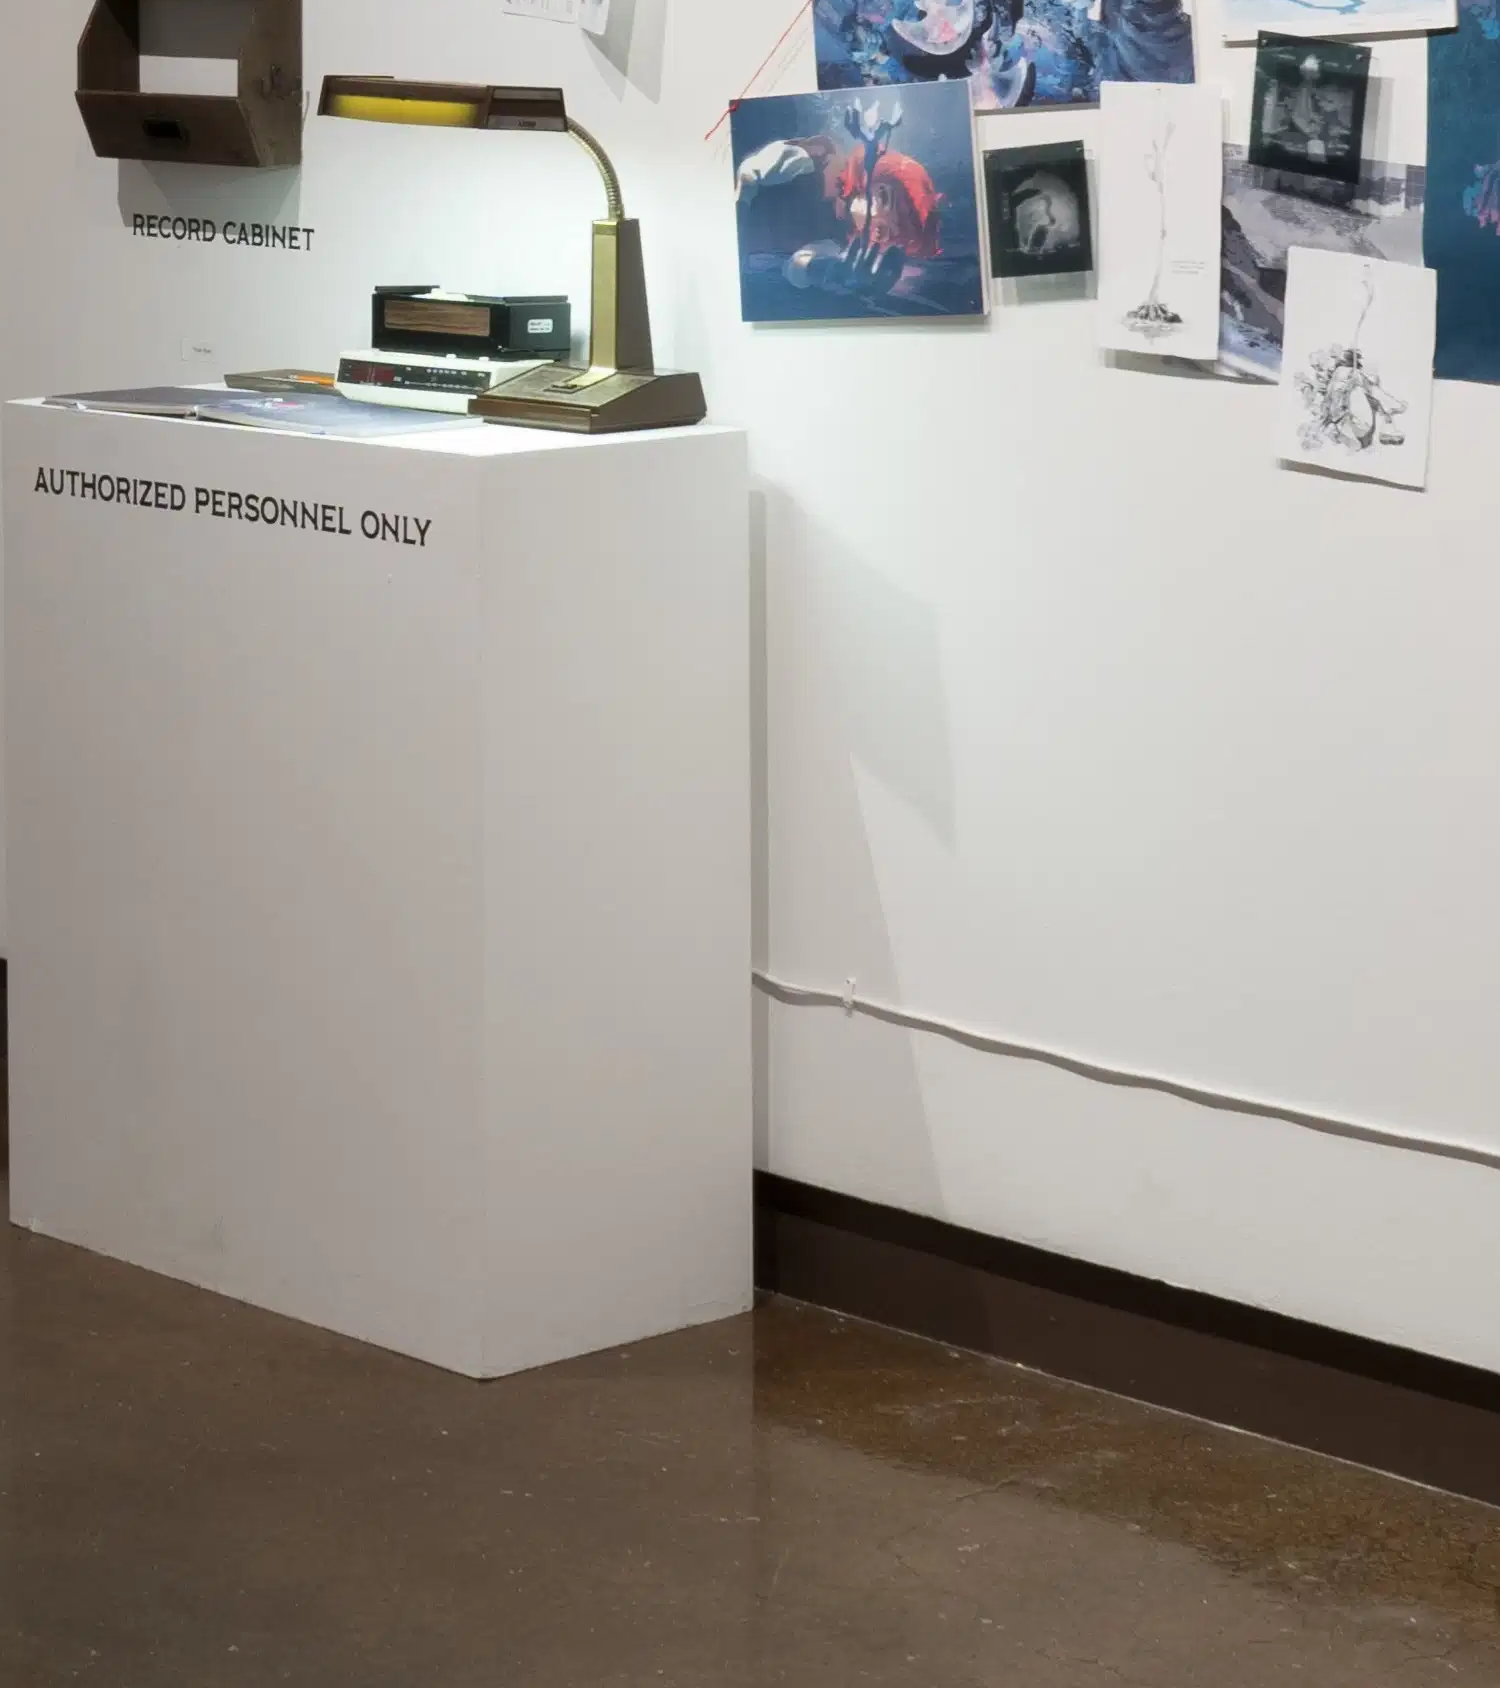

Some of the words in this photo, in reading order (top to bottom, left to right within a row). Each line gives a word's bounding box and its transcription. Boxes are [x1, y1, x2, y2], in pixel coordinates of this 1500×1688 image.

[132, 213, 216, 242] RECORD
[223, 220, 315, 252] CABINET
[34, 466, 186, 511] AUTHORIZED
[194, 487, 352, 535] PERSONNEL
[360, 510, 432, 547] ONLY
